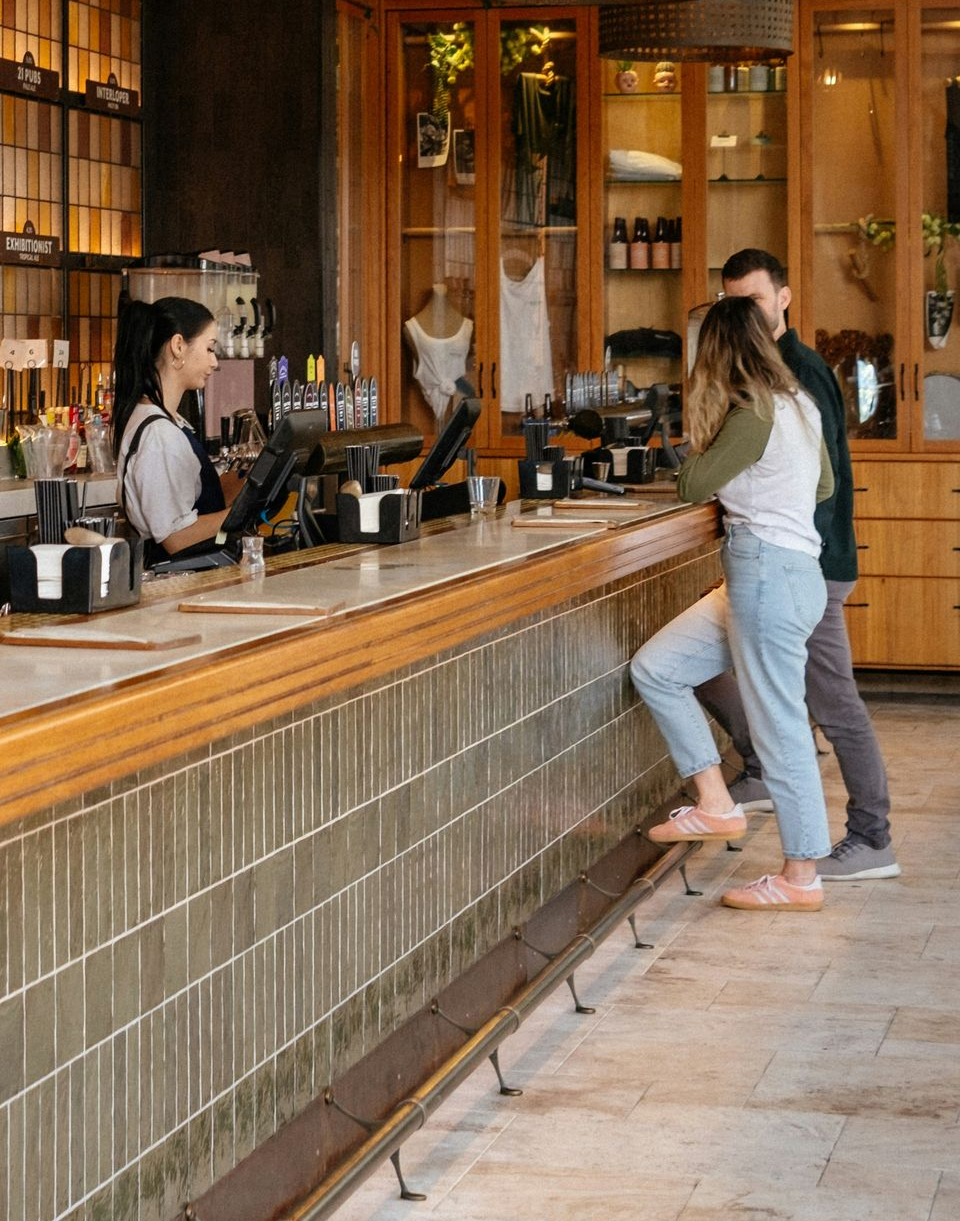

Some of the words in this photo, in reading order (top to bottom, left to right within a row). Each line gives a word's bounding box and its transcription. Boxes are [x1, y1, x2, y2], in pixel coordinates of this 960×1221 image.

[24, 68, 42, 85] PUBS
[96, 85, 130, 105] INTERLOPER
[6, 236, 53, 254] EXHIBITIONIST
